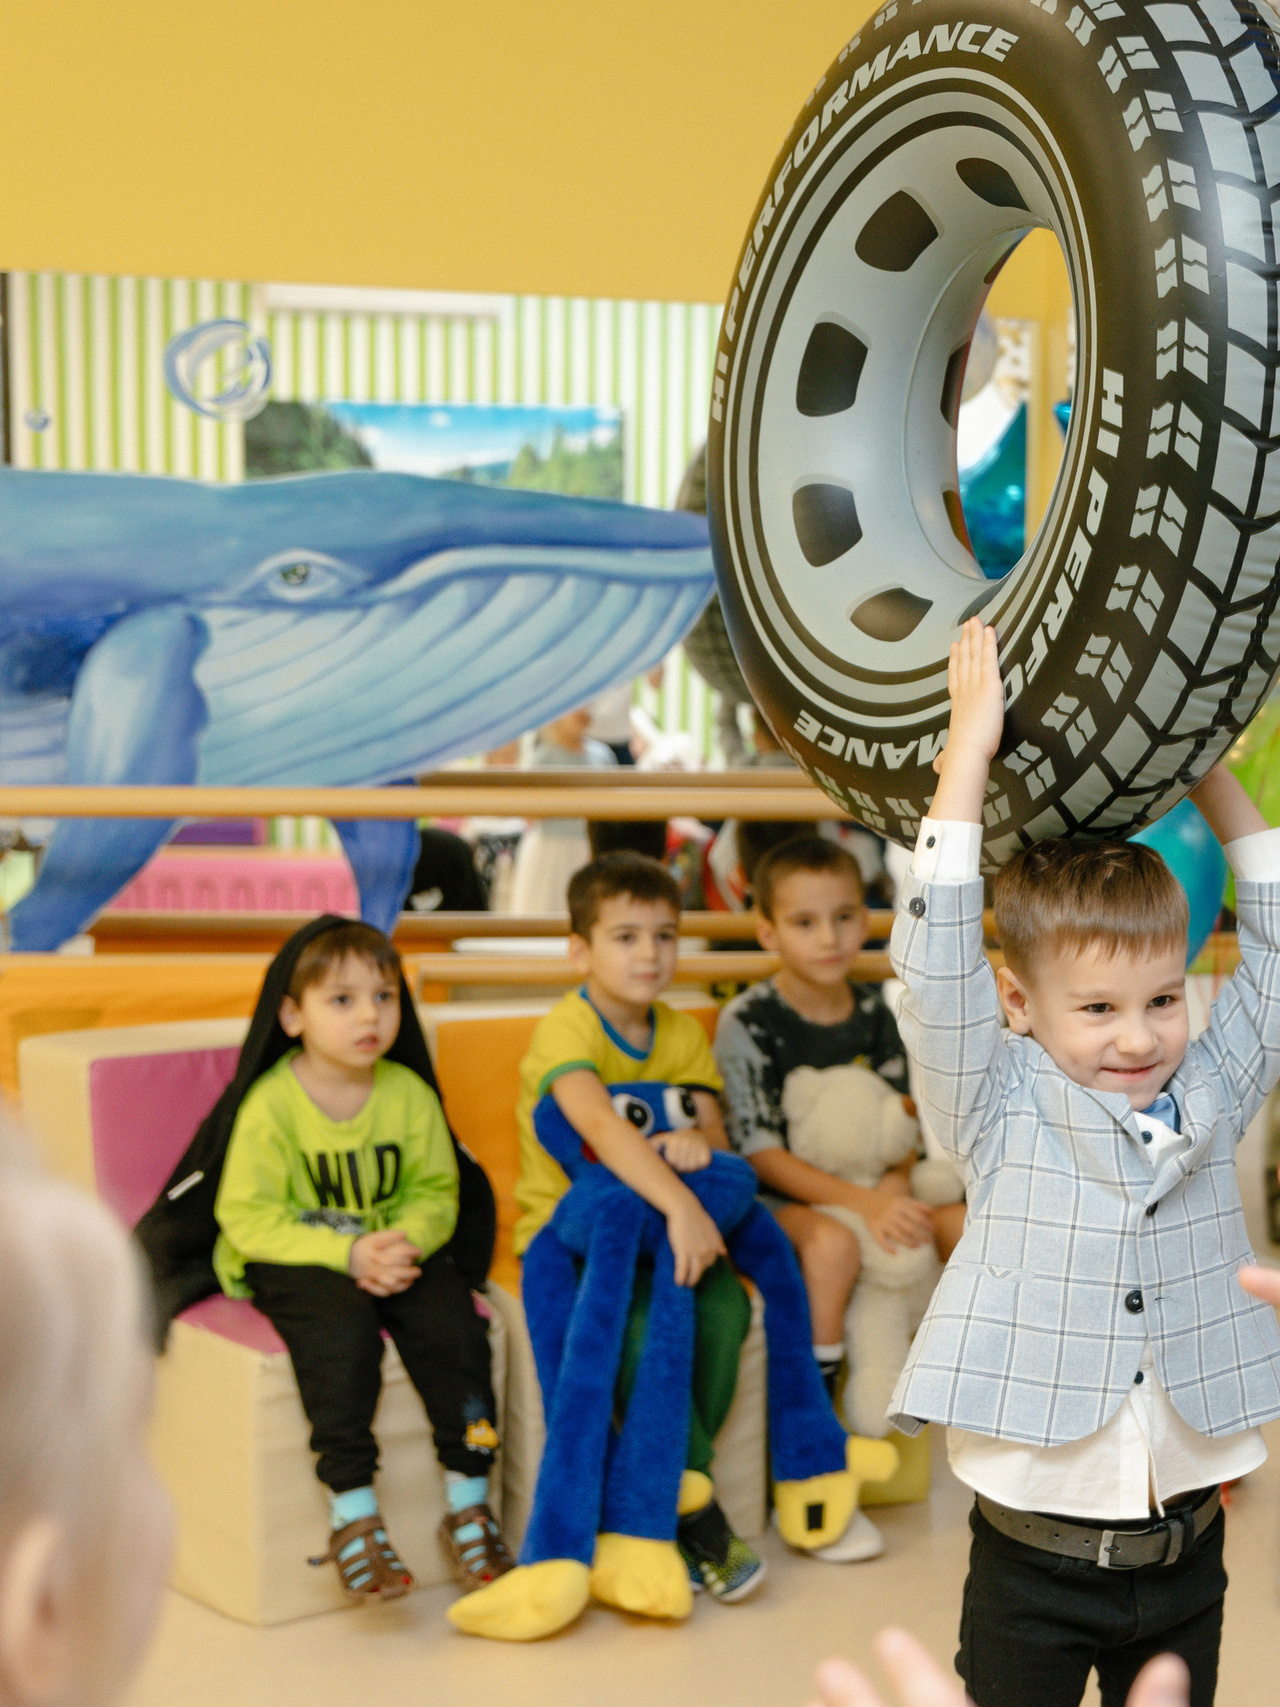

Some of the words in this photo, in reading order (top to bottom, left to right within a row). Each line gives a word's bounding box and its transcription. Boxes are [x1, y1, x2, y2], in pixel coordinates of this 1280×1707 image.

[724, 20, 1020, 343] PERFORMANCE
[1095, 365, 1125, 459] HI
[792, 465, 1110, 770] PERFOMANCE
